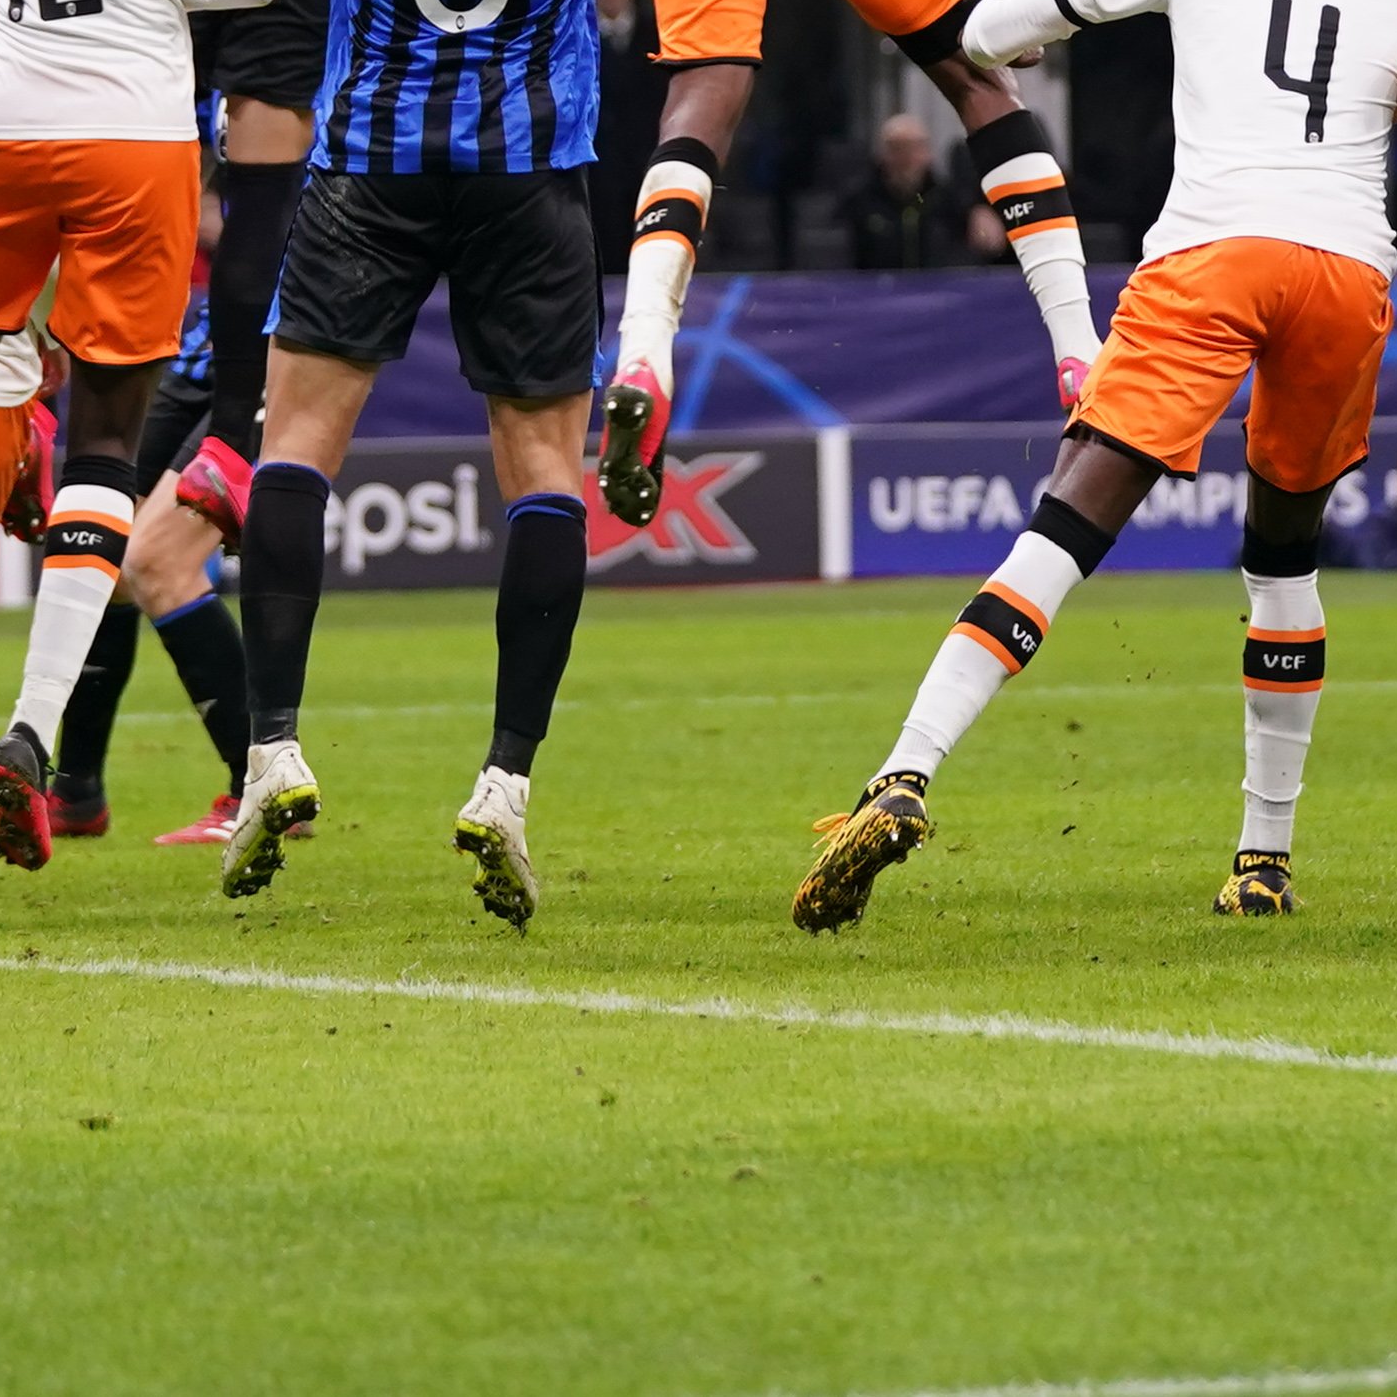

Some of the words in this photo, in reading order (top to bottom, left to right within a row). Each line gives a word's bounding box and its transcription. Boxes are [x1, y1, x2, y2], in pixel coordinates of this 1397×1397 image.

[637, 207, 669, 233] VCF
[1003, 199, 1036, 220] VCF
[868, 475, 1025, 533] UEFA
[324, 463, 480, 576] psi
[61, 529, 105, 547] VCF
[1011, 622, 1038, 654] VCF
[1263, 651, 1306, 670] VCF
